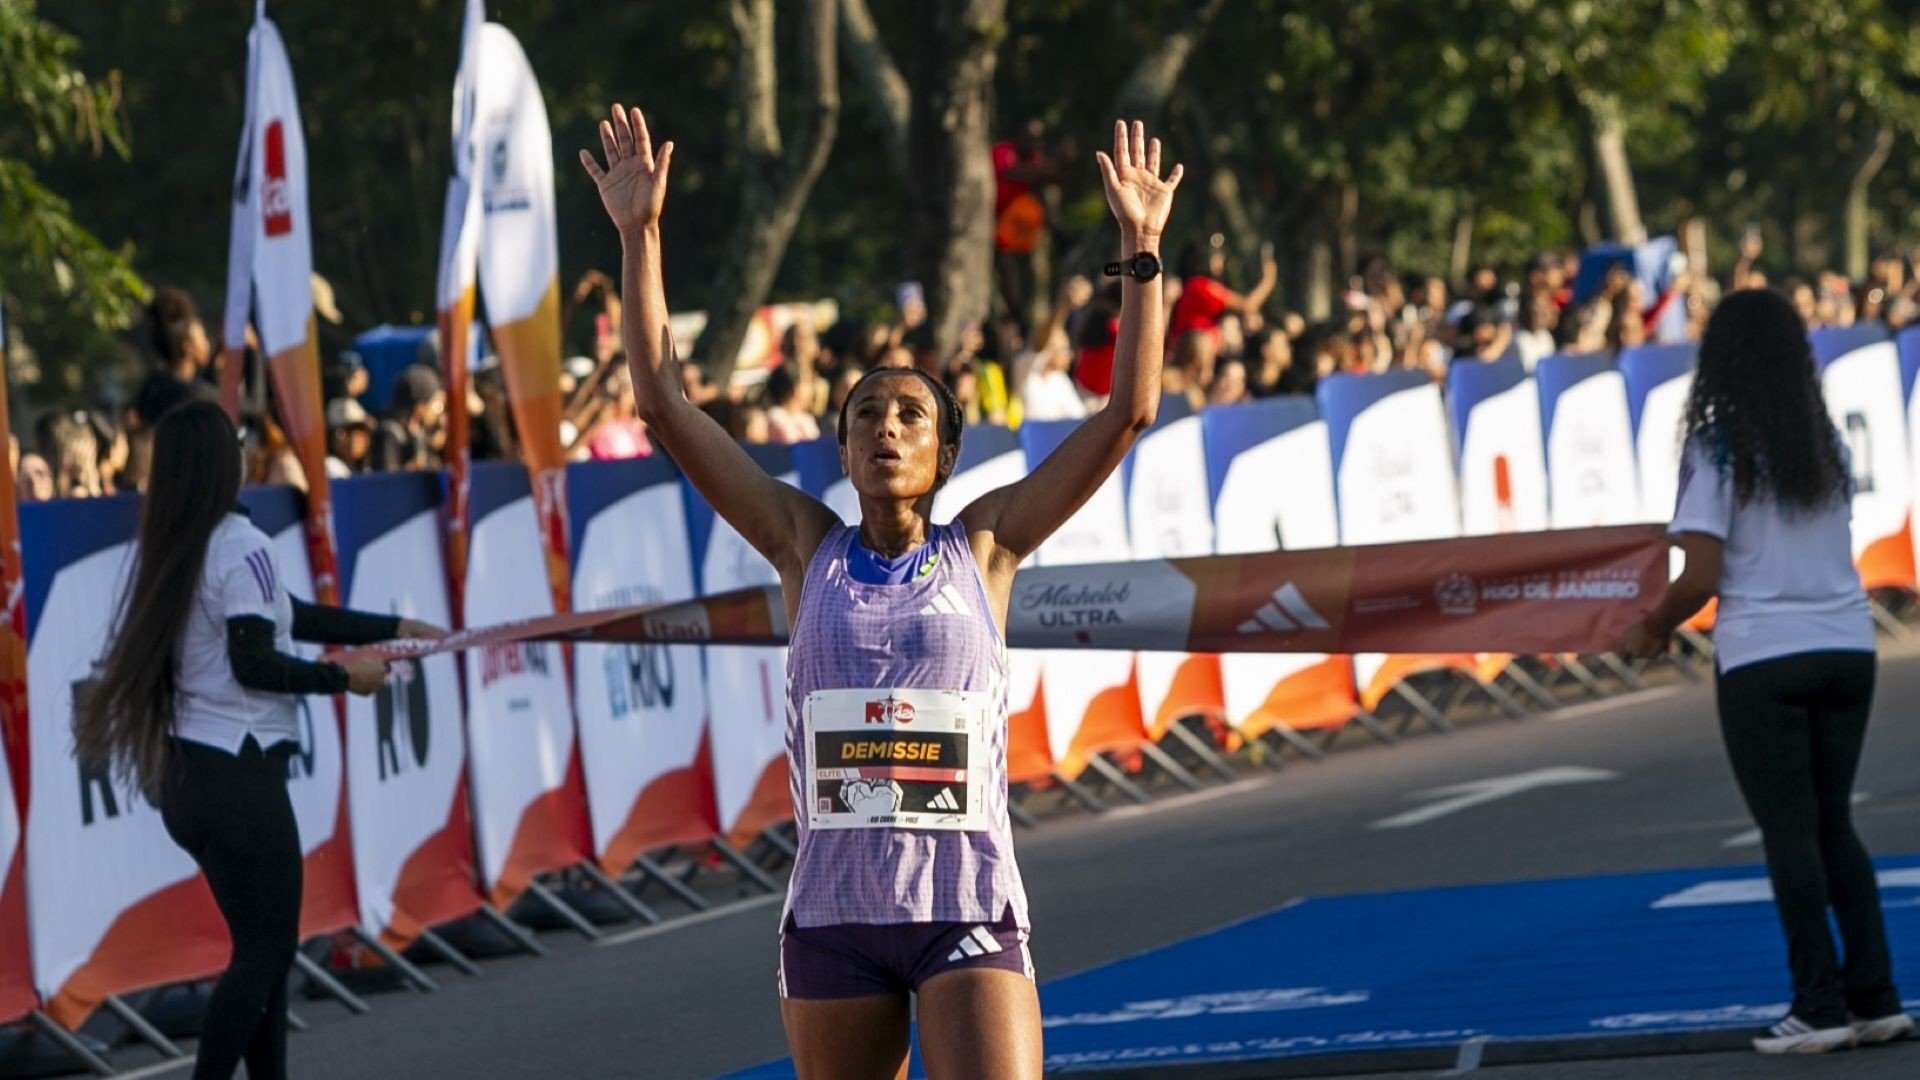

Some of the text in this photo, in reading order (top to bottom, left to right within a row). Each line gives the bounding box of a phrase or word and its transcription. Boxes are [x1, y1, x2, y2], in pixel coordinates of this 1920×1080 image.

[1523, 582, 1551, 599] DE
[1555, 580, 1640, 599] JANEIRO
[649, 617, 706, 639] itaú
[1038, 609, 1123, 628] ULTRA
[841, 741, 942, 761] DEMISSIE
[818, 770, 842, 779] ELITE
